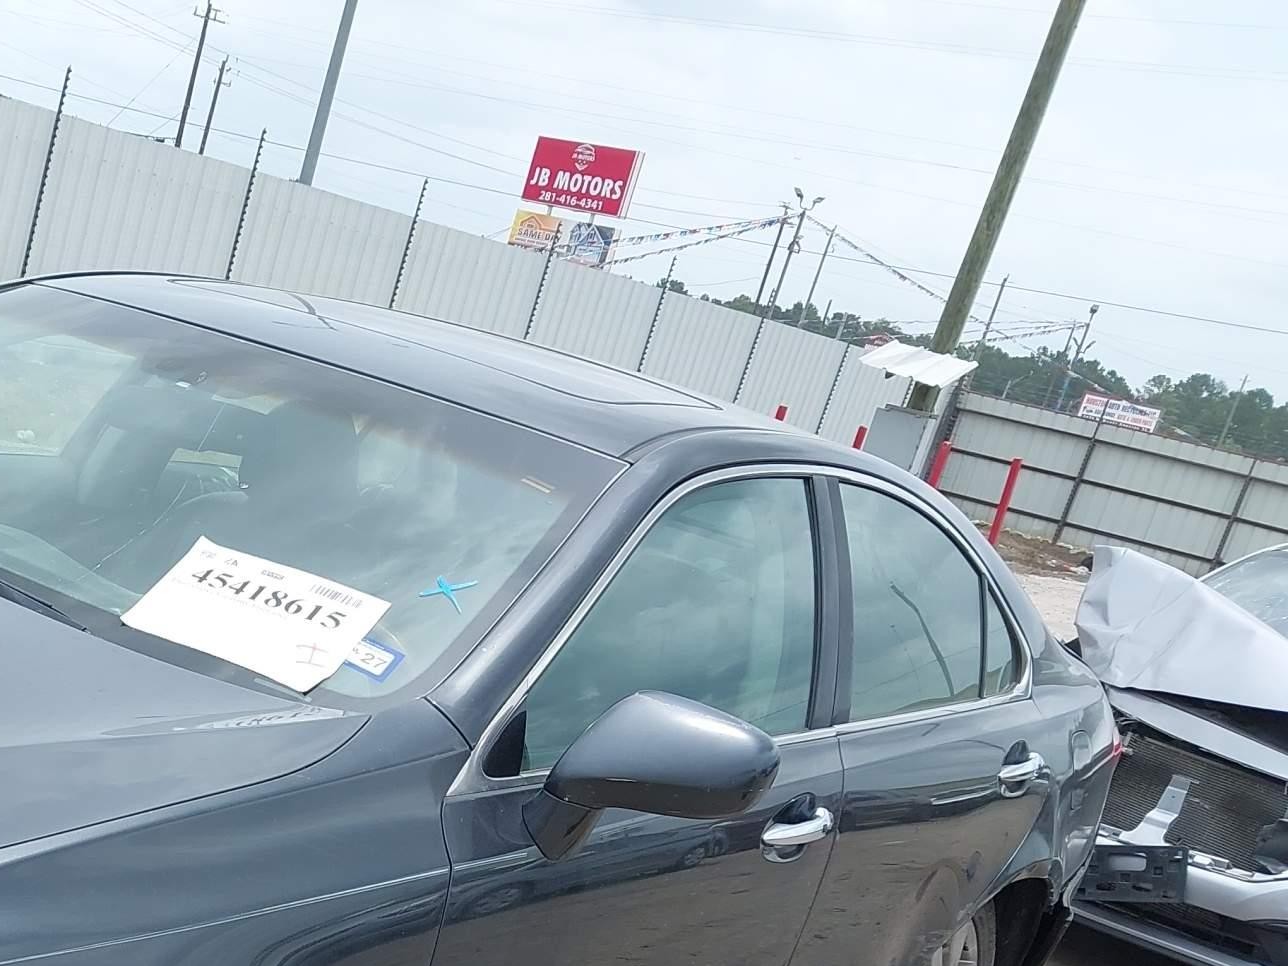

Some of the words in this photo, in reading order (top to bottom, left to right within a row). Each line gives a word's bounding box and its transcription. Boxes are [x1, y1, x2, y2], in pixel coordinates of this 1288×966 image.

[530, 167, 550, 186] JB
[553, 170, 623, 199] MOTORS
[539, 190, 603, 210] 281-416-4341
[517, 228, 543, 240] SAME
[192, 569, 347, 630] 45418615
[360, 652, 388, 669] 27
